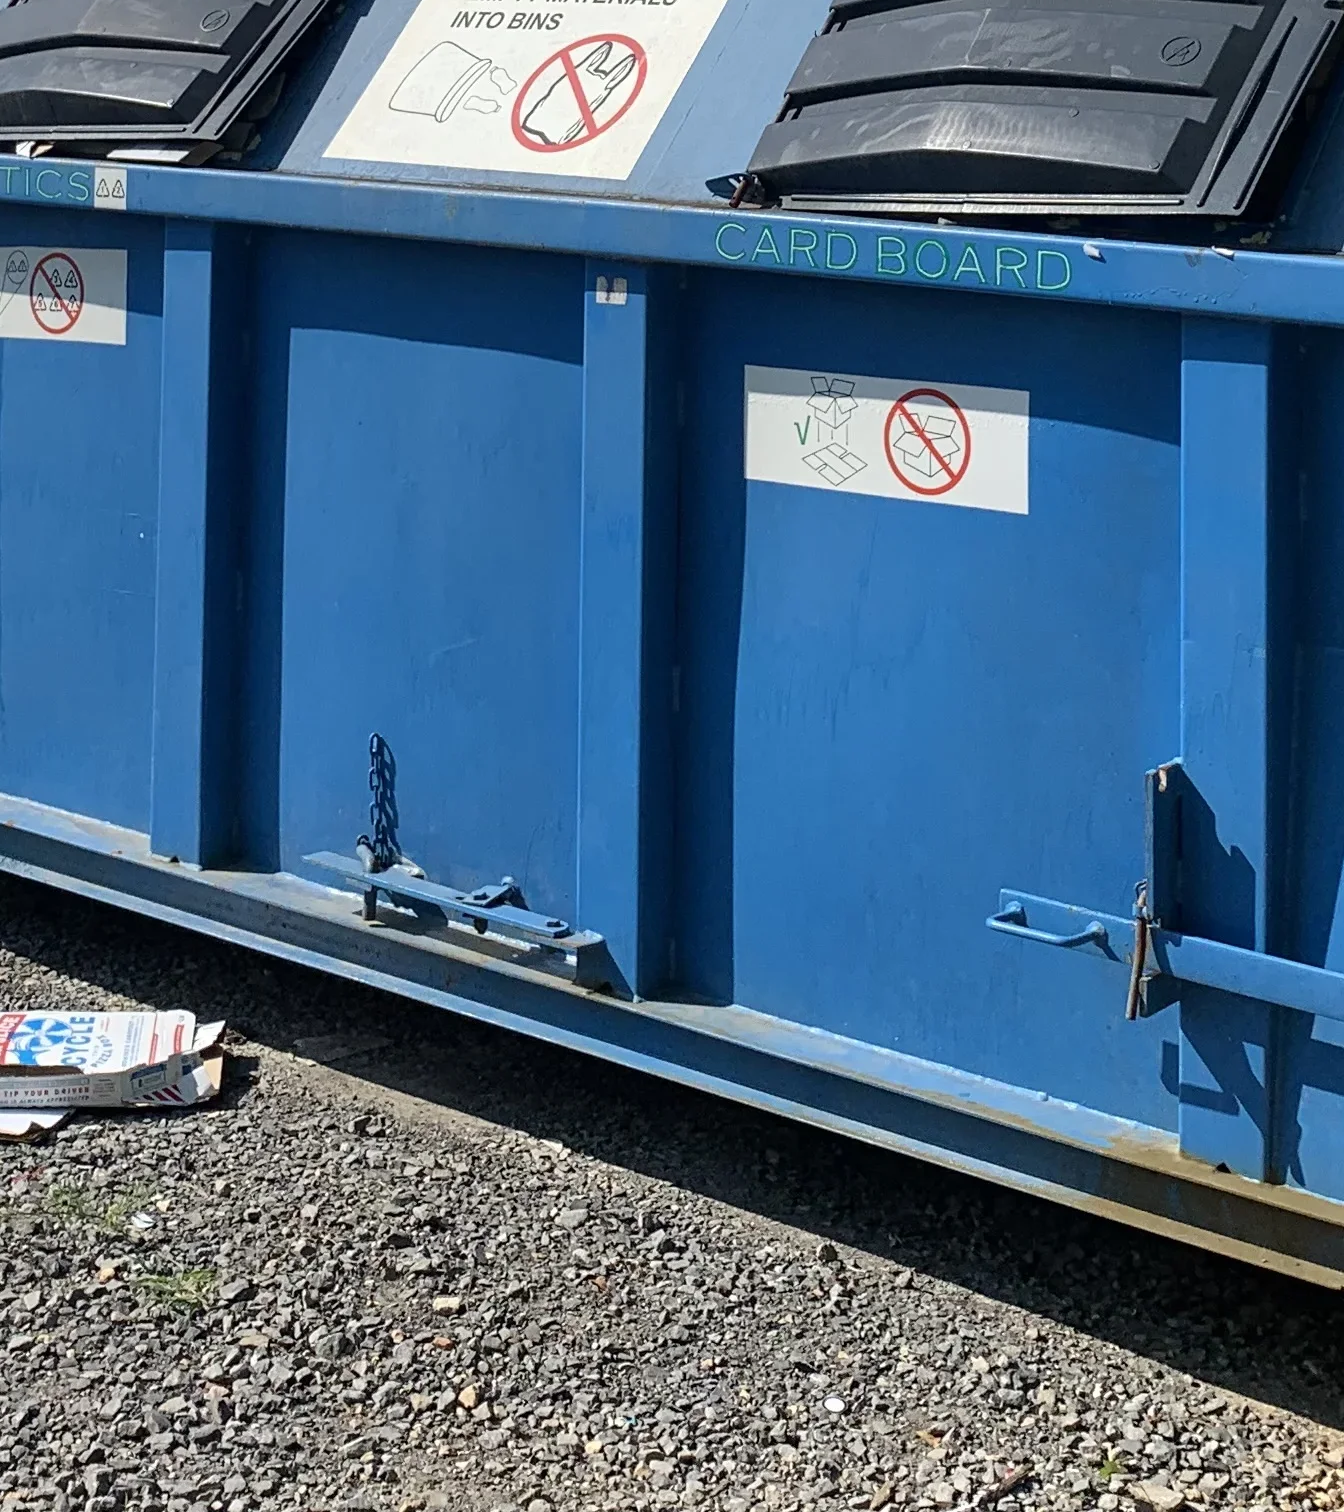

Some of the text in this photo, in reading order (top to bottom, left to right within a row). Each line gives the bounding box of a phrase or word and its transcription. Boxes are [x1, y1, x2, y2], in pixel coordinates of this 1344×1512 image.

[450, 11, 563, 31] INTO BINS
[714, 222, 1072, 291] CARD BOARD
[97, 1034, 112, 1047] BOX
[91, 1048, 112, 1067] PIZZA
[54, 1087, 89, 1095] DRIVER
